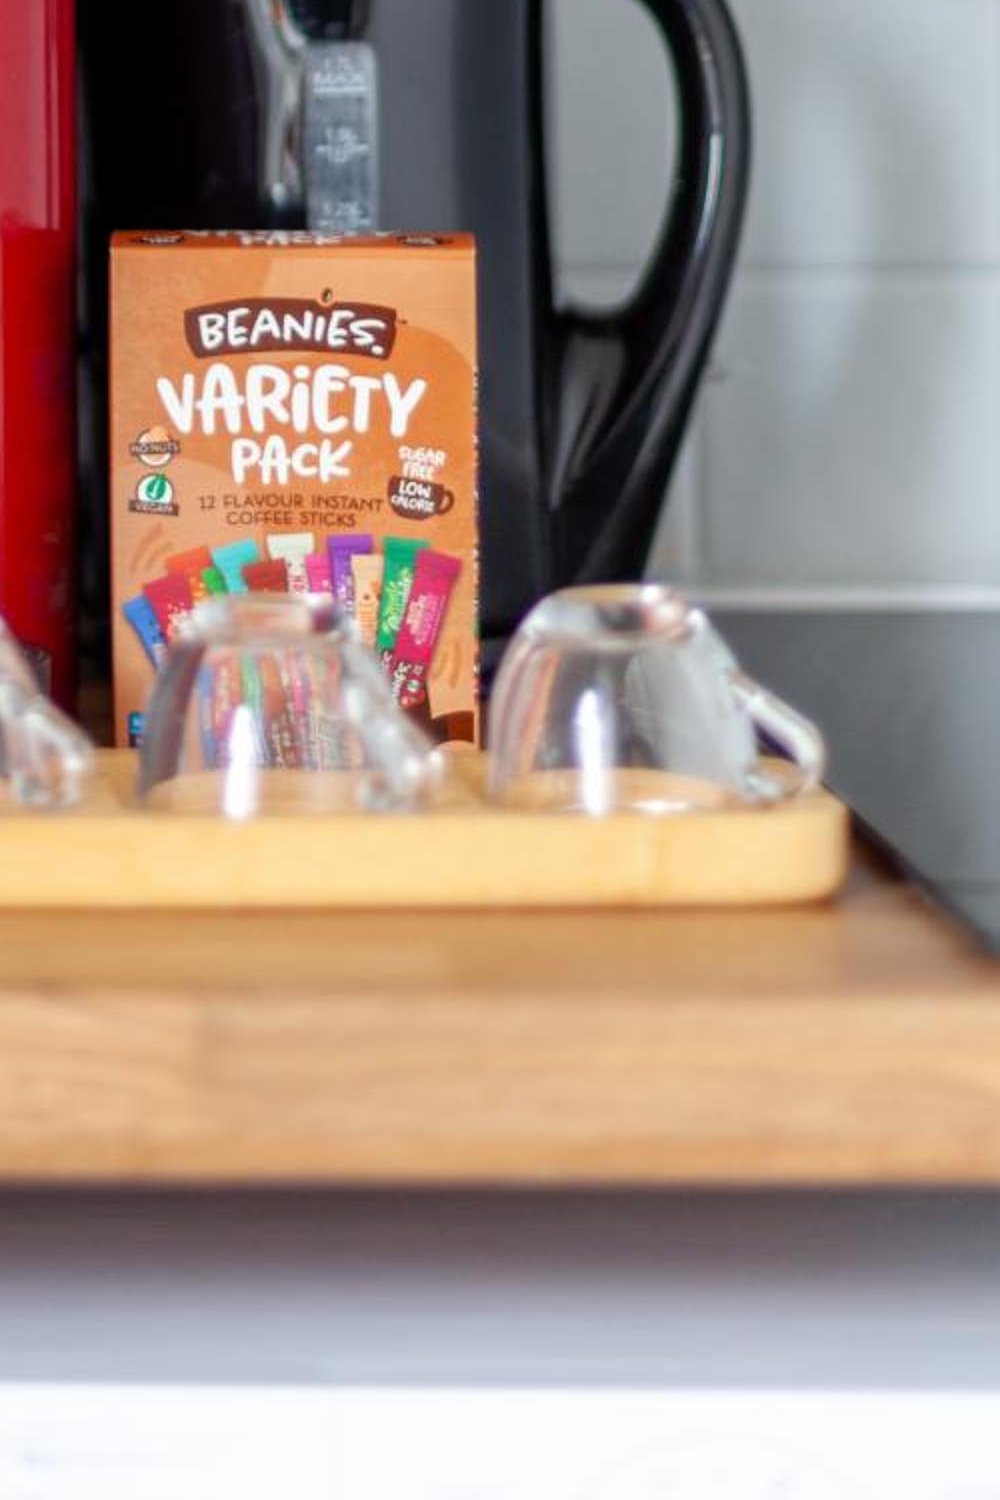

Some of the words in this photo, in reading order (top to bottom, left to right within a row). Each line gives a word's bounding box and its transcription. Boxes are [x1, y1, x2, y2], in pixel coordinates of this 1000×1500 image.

[230, 435, 353, 485] PACK
[398, 445, 447, 467] SUGAR
[403, 461, 435, 481] FREE
[399, 480, 432, 498] LOW
[135, 502, 174, 513] VEGAN
[199, 495, 215, 510] 12
[223, 494, 304, 510] FLAVOUR
[311, 495, 384, 513] INSTANT
[226, 512, 294, 526] COFFEE
[300, 512, 357, 528] STICKS
